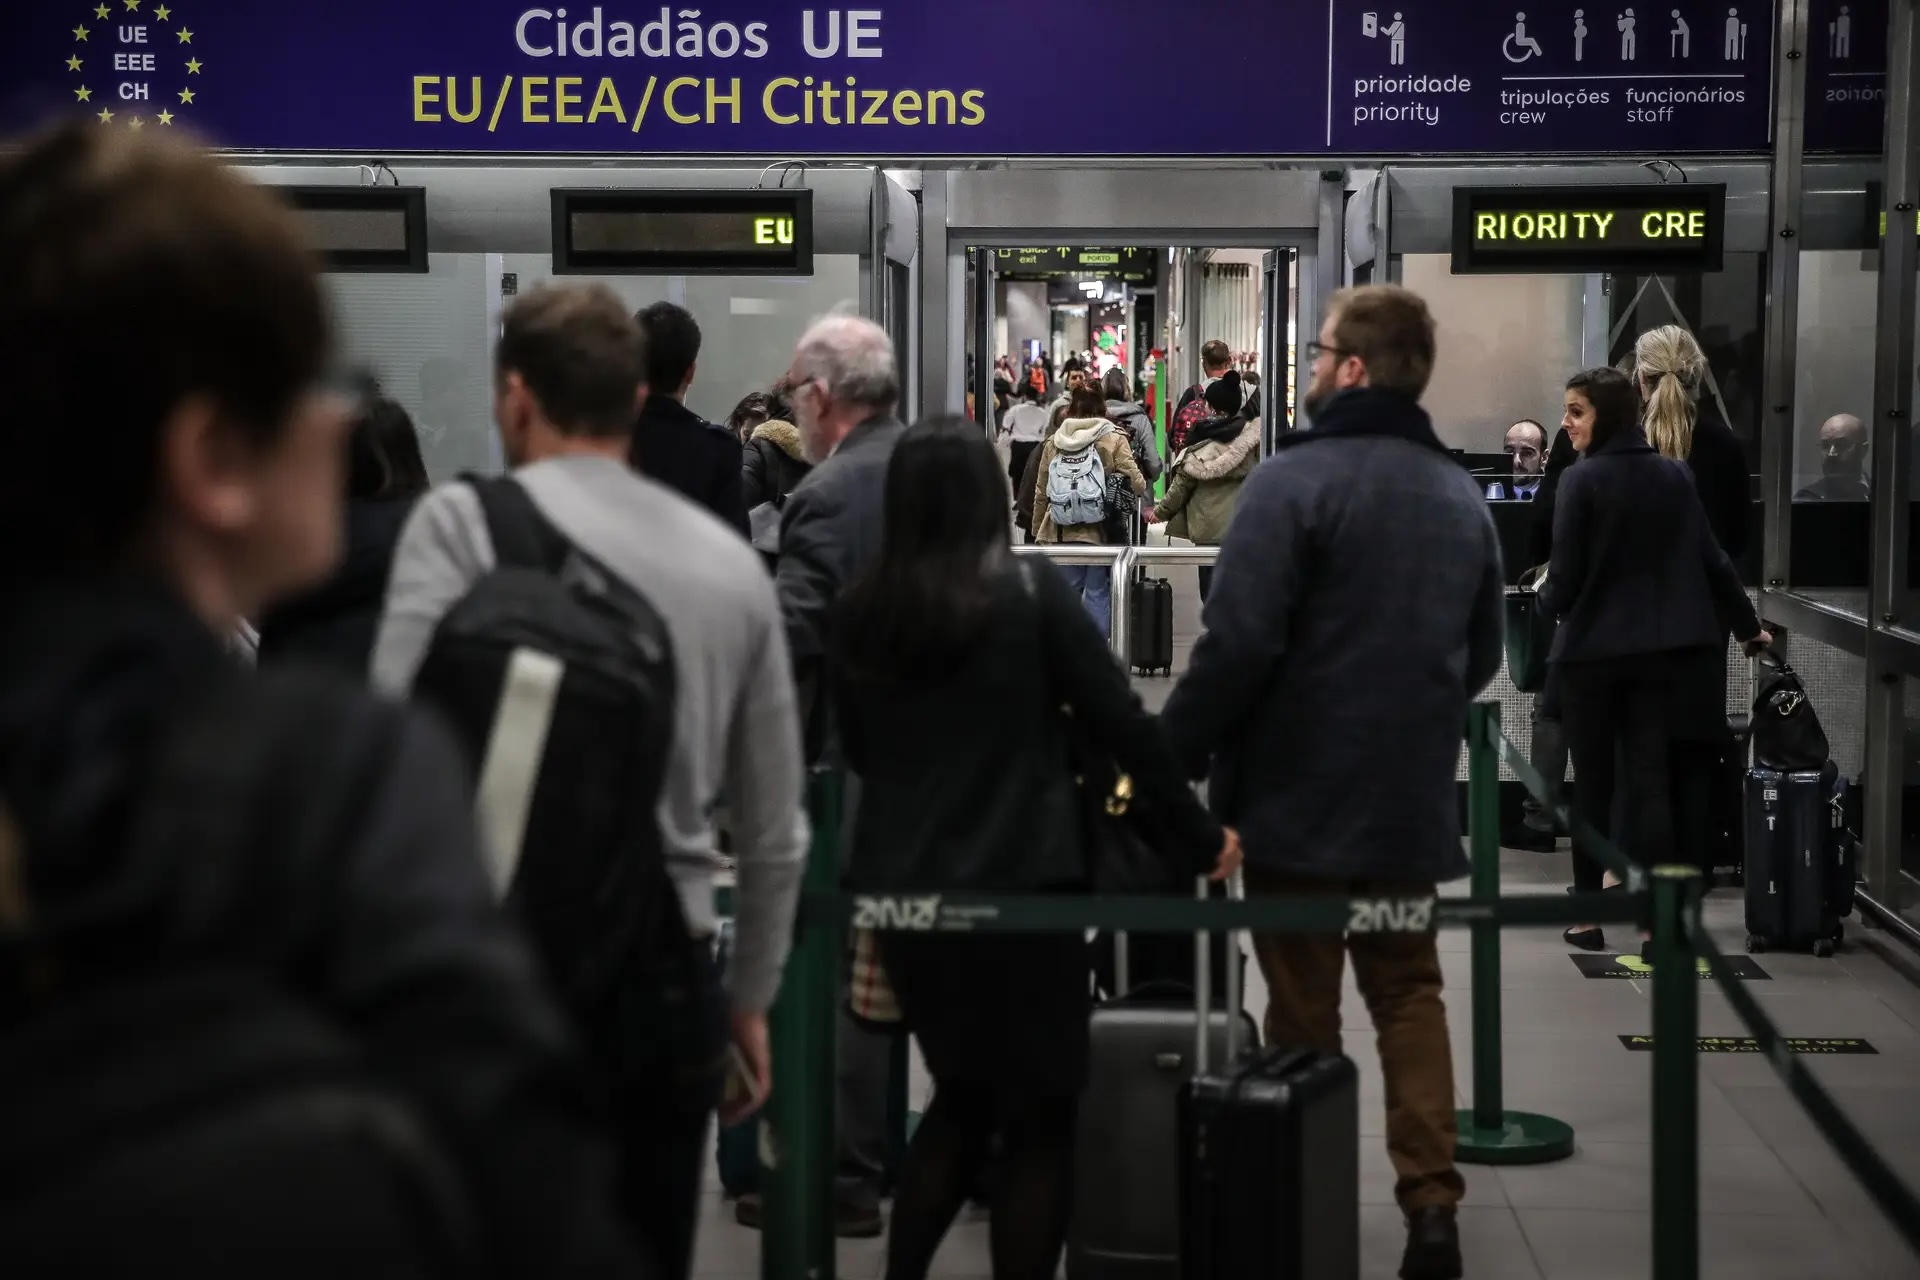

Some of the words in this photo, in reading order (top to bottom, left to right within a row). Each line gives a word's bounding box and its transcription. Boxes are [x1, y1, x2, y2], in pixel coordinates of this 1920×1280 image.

[118, 25, 148, 43] UE
[515, 6, 769, 58] Cidadãos
[802, 10, 883, 58] UE
[114, 53, 156, 71] EEE
[118, 82, 149, 100] CH
[1354, 74, 1471, 96] prioridade
[1625, 86, 1745, 104] funcionários
[413, 75, 741, 133] EU/EEA/CH
[762, 76, 985, 126] Citizens
[1500, 88, 1610, 109] tripulações
[1354, 101, 1439, 126] priority
[1500, 111, 1546, 124] crew
[1626, 106, 1674, 123] staff
[754, 217, 794, 244] EU
[1477, 212, 1614, 239] RIORITY
[1641, 211, 1704, 238] CRE
